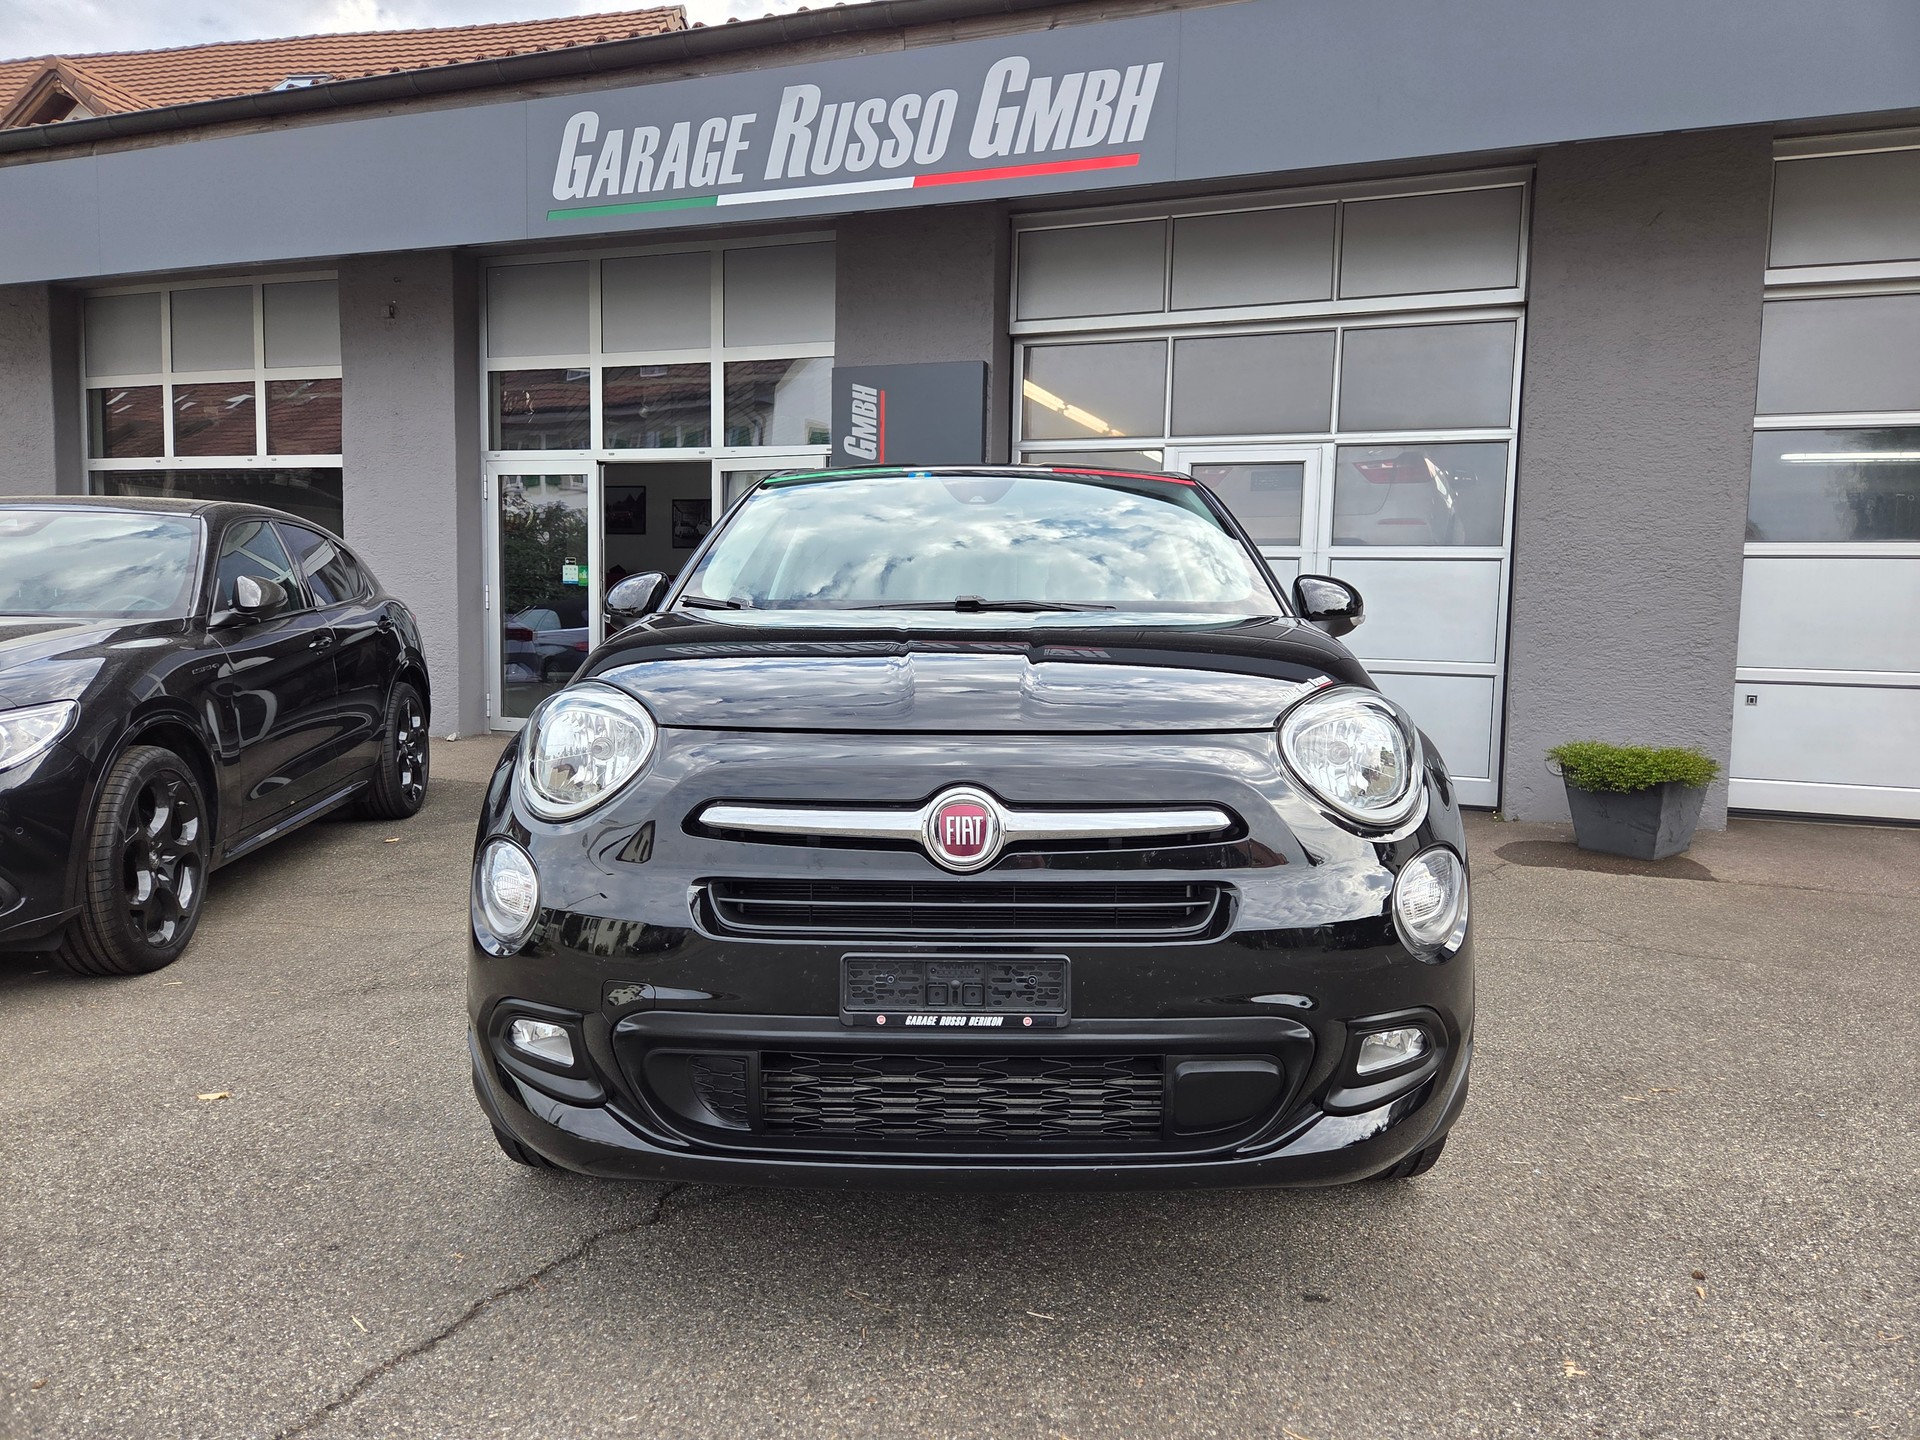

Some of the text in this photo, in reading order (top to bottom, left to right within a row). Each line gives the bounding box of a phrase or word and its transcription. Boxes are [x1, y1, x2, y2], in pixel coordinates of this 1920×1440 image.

[552, 55, 1164, 201] GARAGE RUSSO GMBH
[843, 383, 878, 461] GMBH
[946, 815, 984, 846] FIAT
[905, 1015, 938, 1026] GARAGE
[939, 1016, 967, 1027] RUSSO
